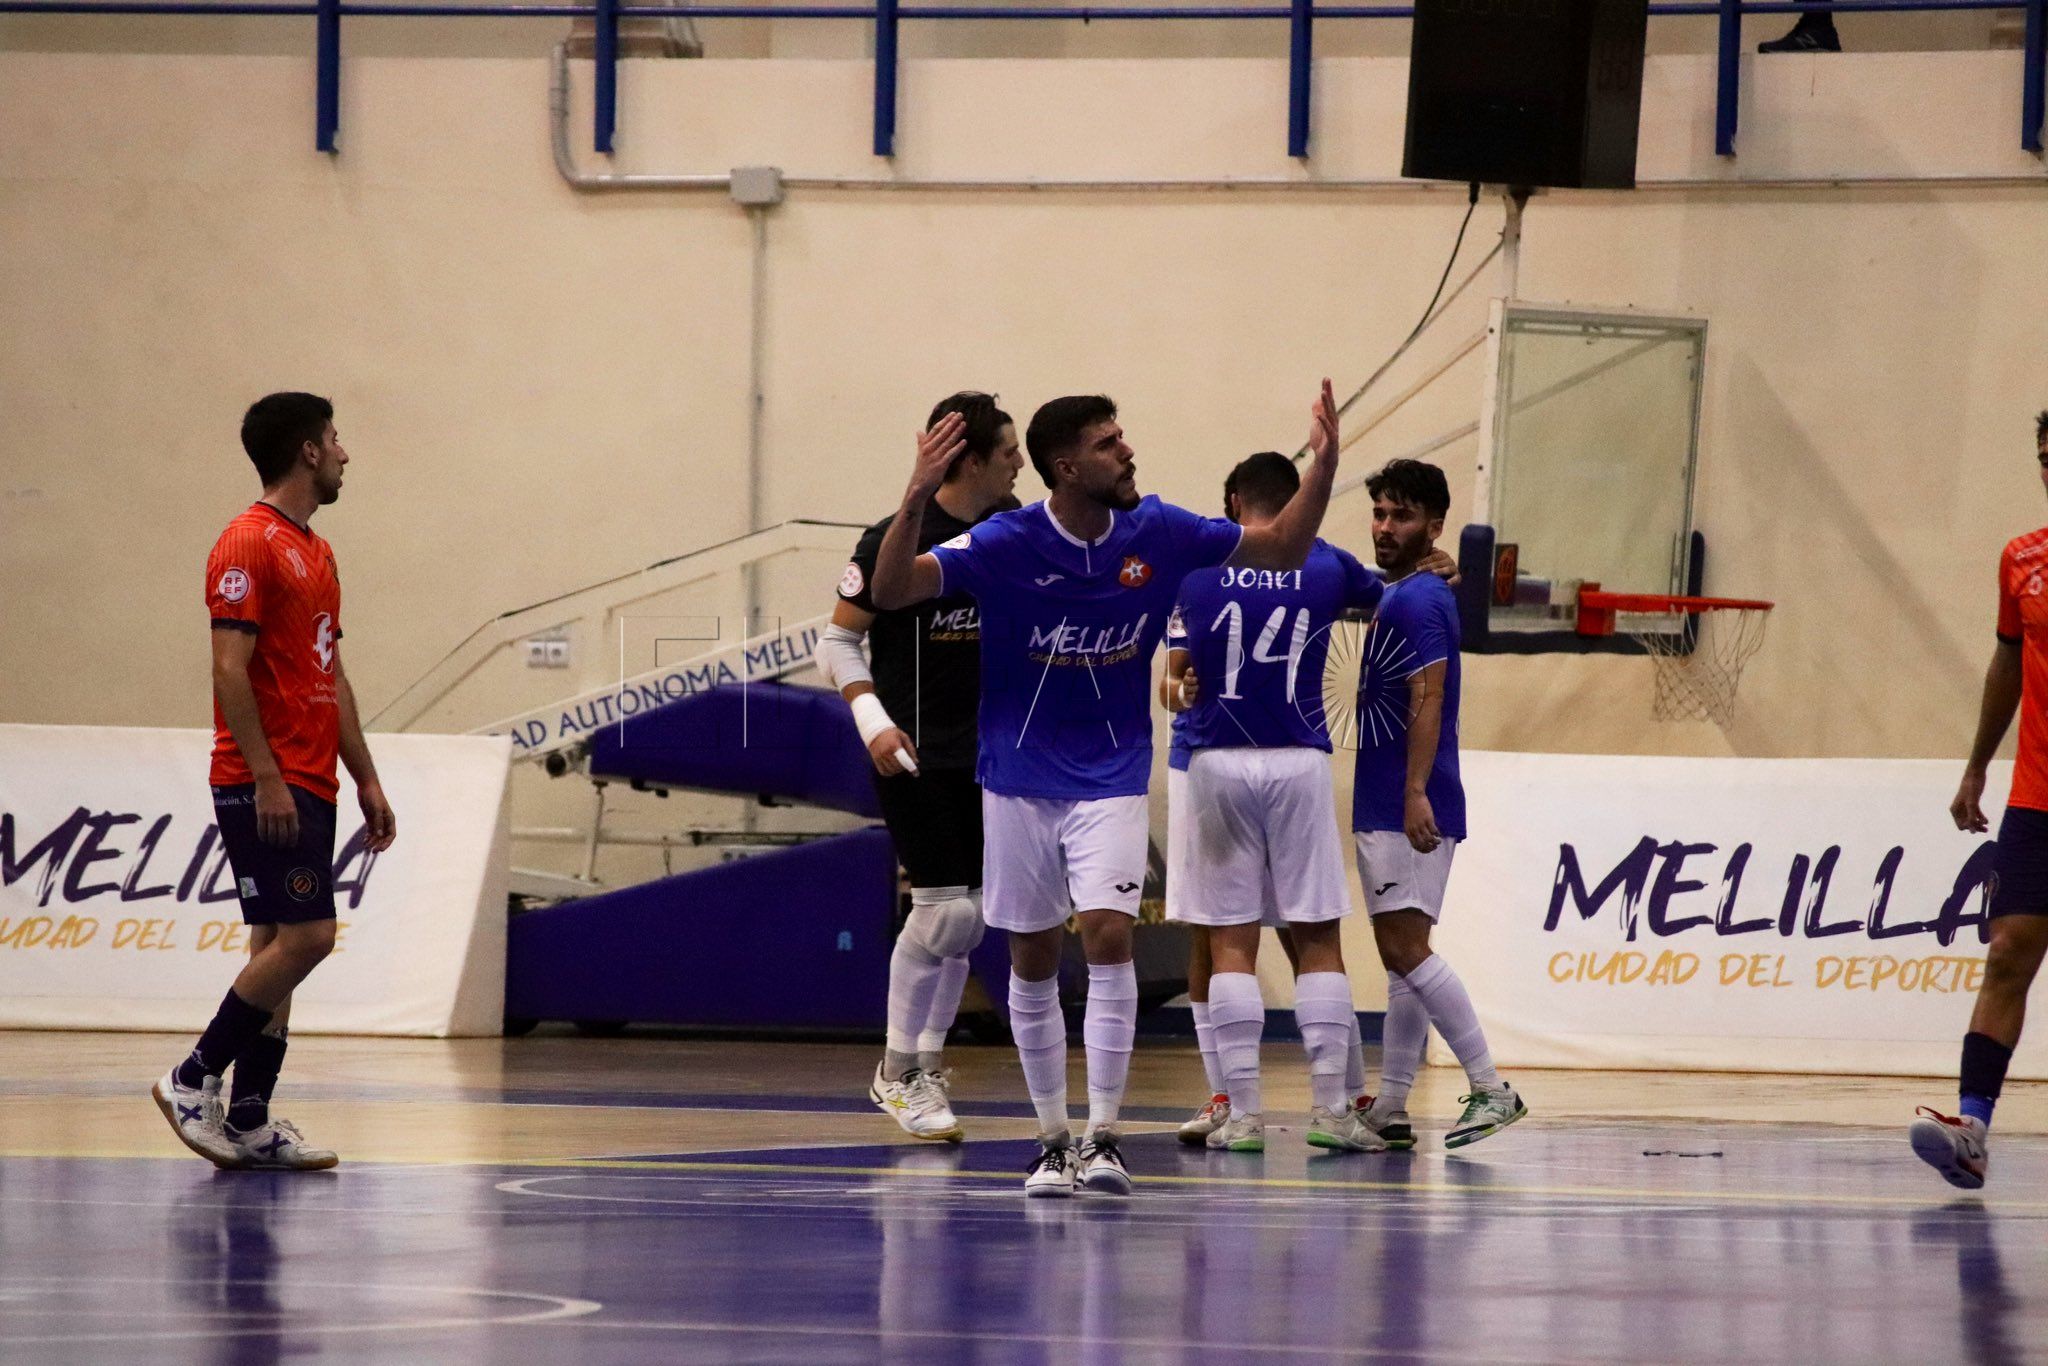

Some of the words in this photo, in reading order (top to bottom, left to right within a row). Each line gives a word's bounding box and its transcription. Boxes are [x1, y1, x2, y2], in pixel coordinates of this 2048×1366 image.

[1220, 566, 1302, 590] JOAKI
[1210, 601, 1310, 704] 14
[1543, 835, 1999, 947] MELILLA
[112, 918, 176, 951] DEL
[1548, 949, 1700, 986] CIUDAD
[1719, 953, 1793, 988] DEL
[1816, 955, 1988, 993] DEPORTE
